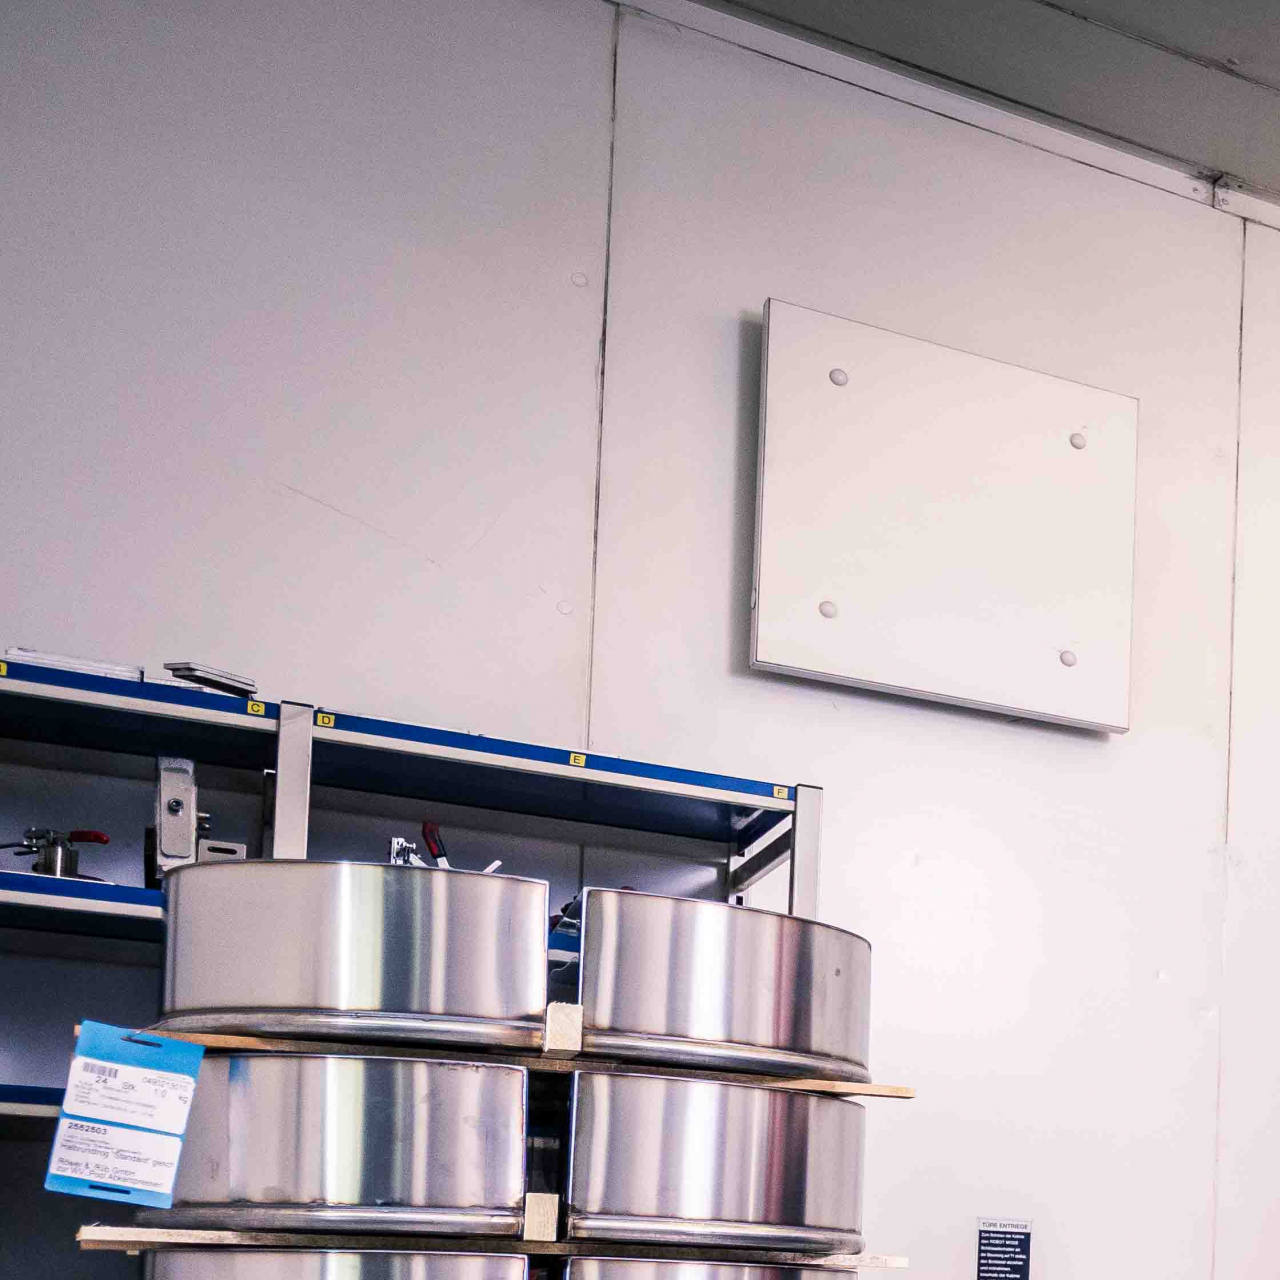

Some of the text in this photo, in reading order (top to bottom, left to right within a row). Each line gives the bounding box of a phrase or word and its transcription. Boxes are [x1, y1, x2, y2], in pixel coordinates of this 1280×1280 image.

[251, 704, 260, 712] C
[322, 716, 331, 724] D
[574, 755, 580, 764] E
[96, 1075, 108, 1085] 24
